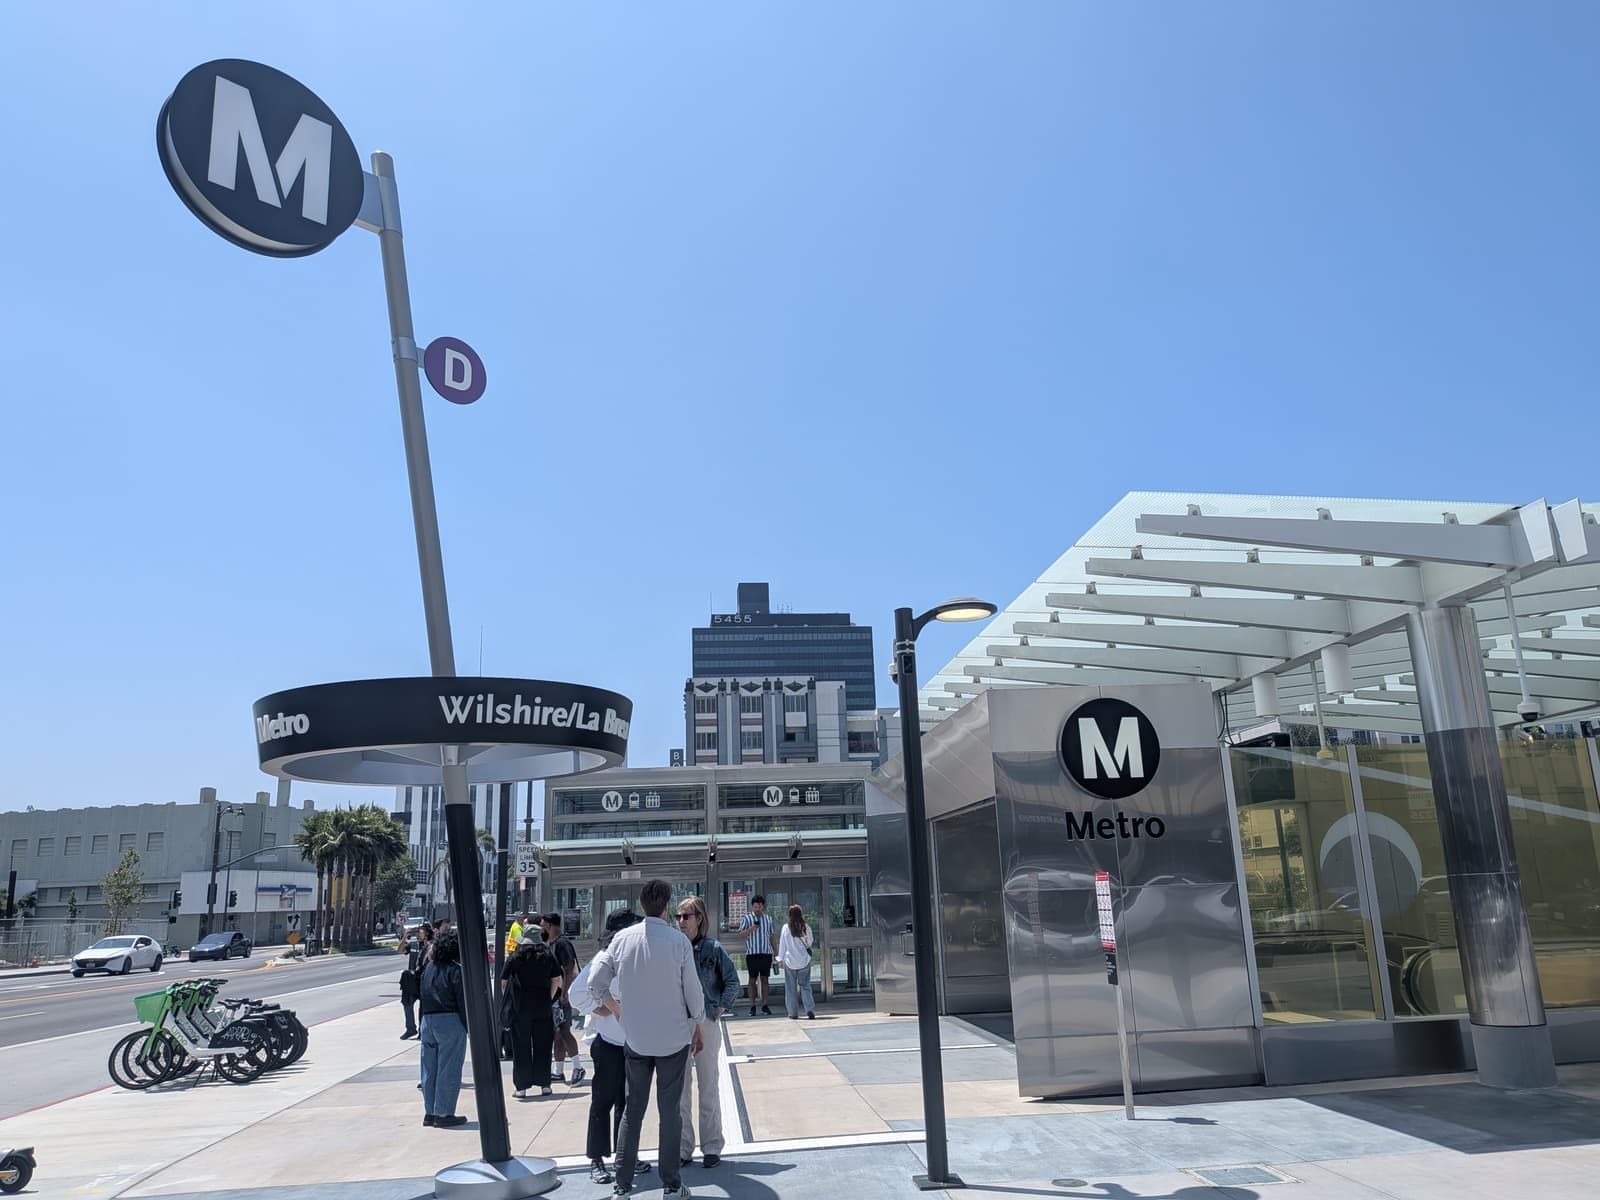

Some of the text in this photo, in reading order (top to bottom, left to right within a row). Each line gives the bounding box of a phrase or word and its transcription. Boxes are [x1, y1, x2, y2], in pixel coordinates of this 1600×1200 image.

[207, 75, 333, 226] M
[444, 347, 472, 391] D
[714, 614, 752, 624] 5455
[438, 693, 600, 731] Wilshire/La
[256, 712, 310, 744] Metro
[1078, 716, 1145, 779] M
[605, 794, 619, 808] M
[766, 789, 780, 803] M
[1065, 811, 1166, 841] Metro
[520, 861, 536, 873] 35
